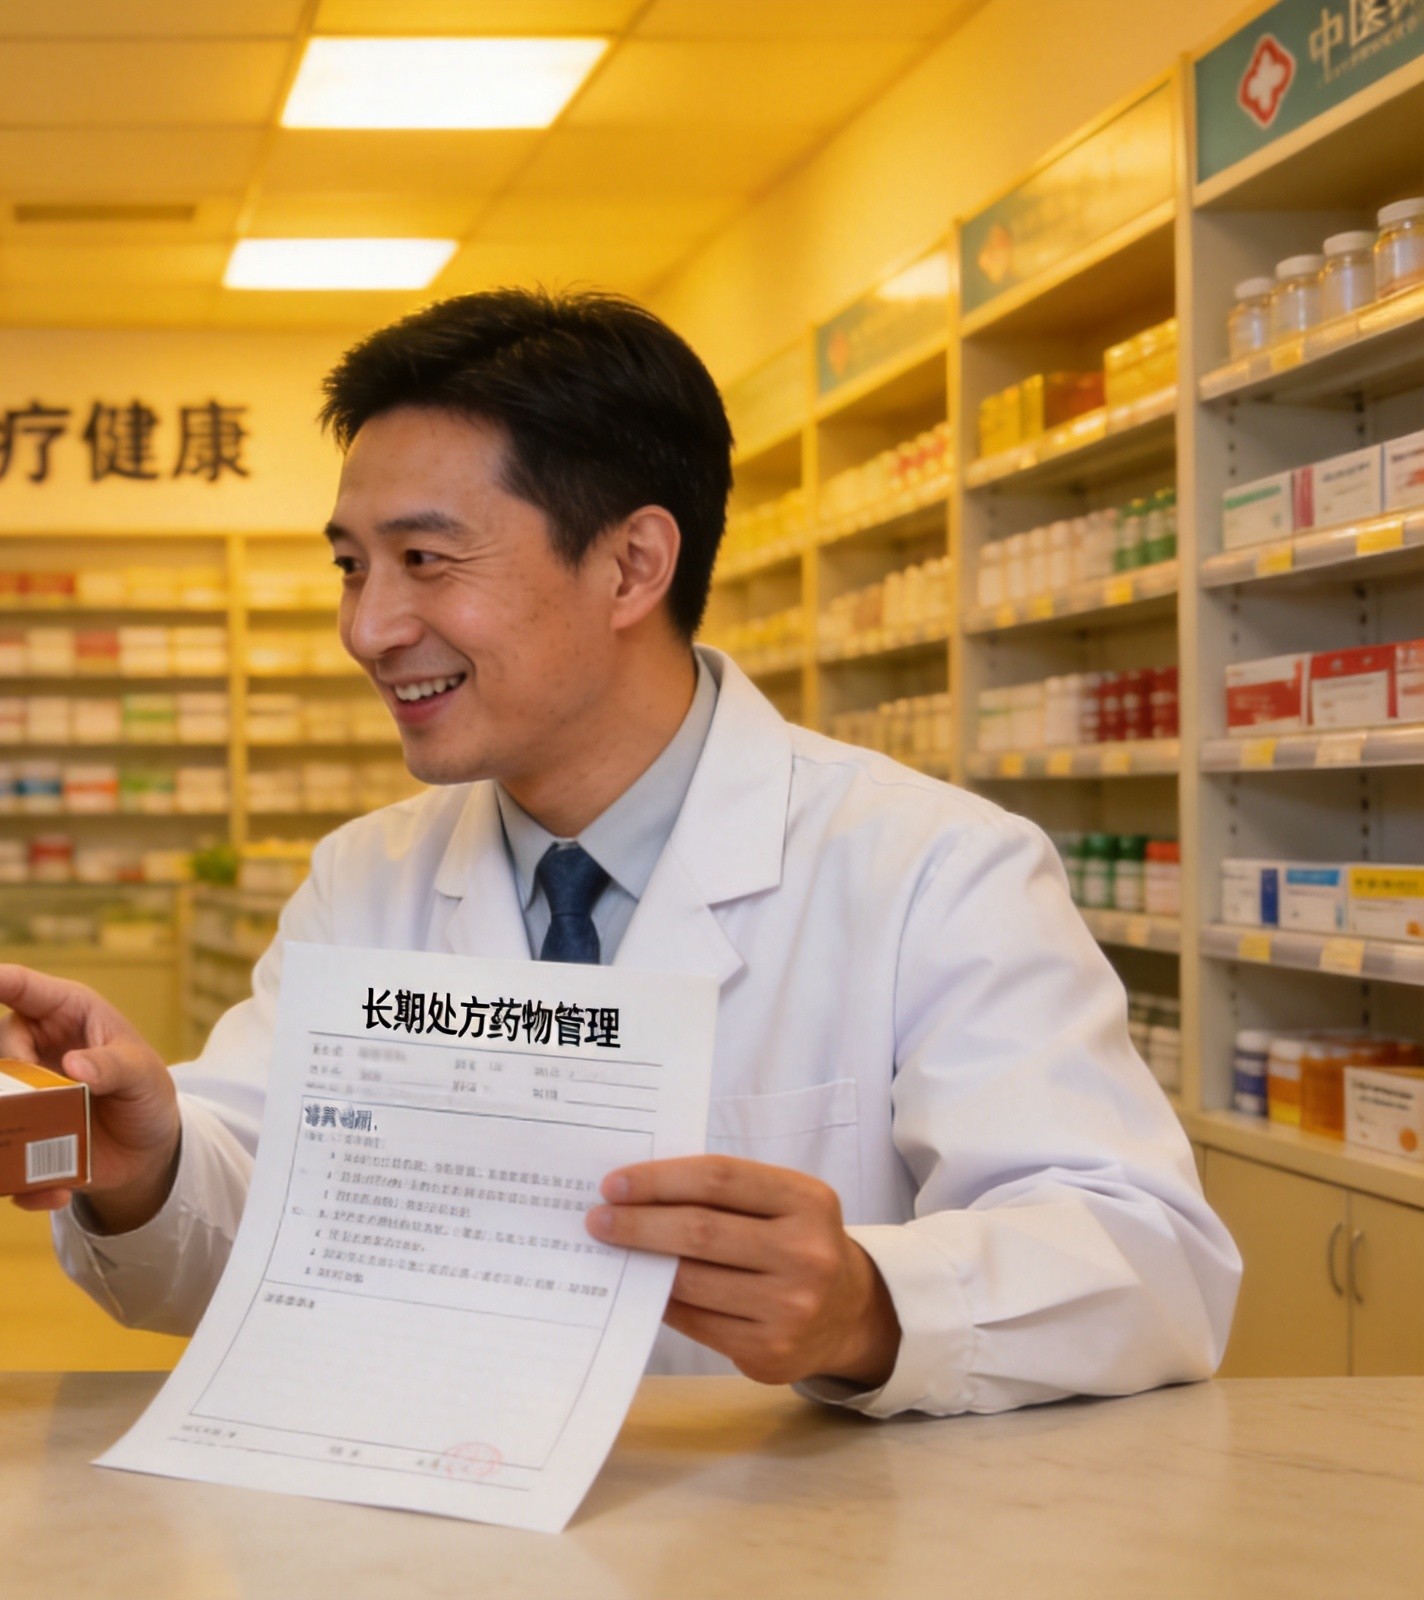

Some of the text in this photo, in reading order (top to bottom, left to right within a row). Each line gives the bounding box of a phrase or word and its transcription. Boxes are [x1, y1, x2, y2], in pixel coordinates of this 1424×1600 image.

[362, 988, 621, 1048] 长期处方药物管理
